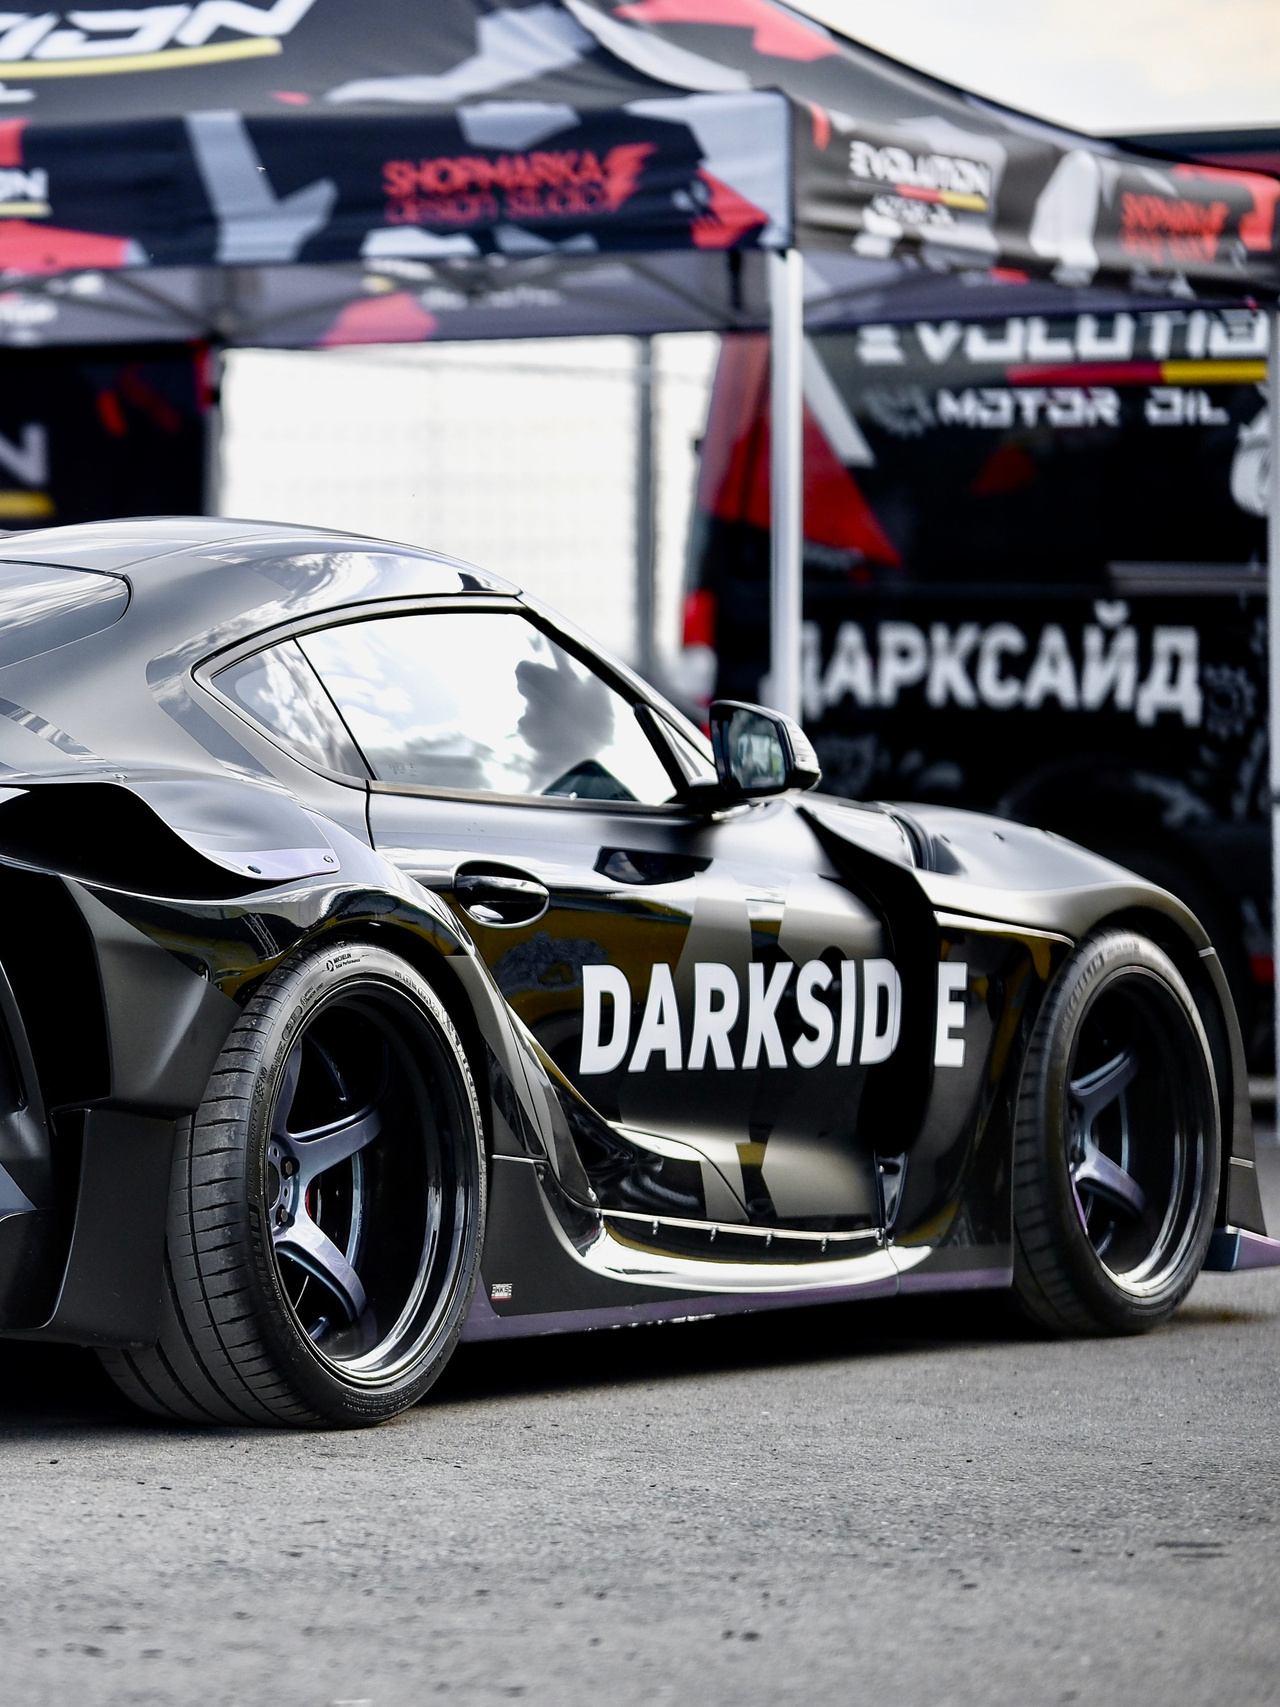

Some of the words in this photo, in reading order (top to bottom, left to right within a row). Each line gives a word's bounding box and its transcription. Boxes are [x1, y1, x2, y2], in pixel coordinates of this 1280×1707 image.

[849, 140, 990, 198] EVOLUTION
[937, 387, 1120, 428] MOTOR
[1144, 387, 1231, 426] OIL
